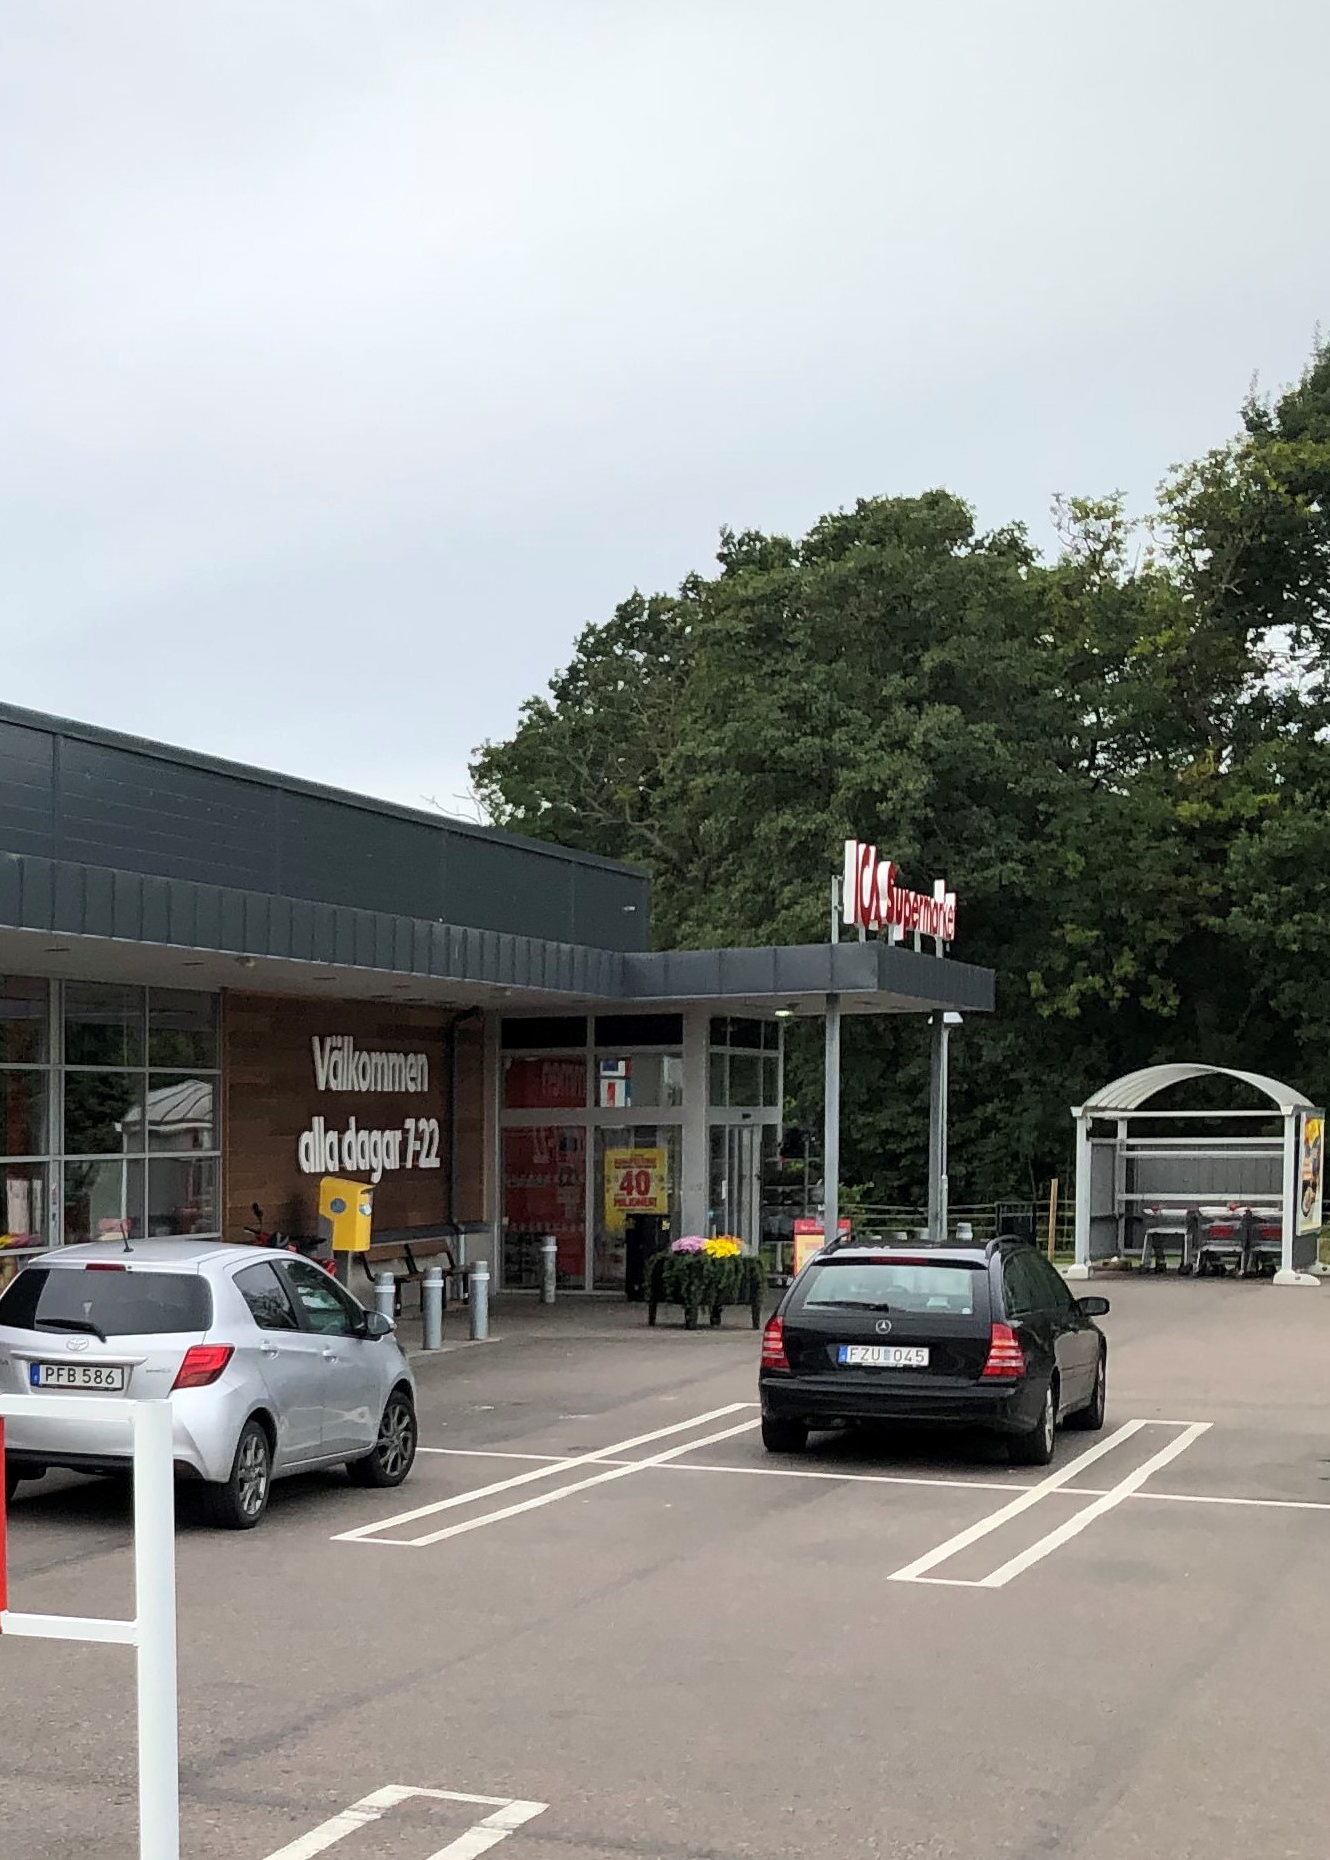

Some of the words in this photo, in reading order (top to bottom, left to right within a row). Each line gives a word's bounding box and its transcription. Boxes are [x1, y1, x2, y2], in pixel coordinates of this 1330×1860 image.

[311, 1035, 429, 1092] Välkommen
[298, 1115, 339, 1173] alla
[341, 1115, 402, 1184] dagar
[404, 1117, 440, 1169] 7-22
[620, 1170, 651, 1196] 40
[849, 1347, 881, 1361] FZU
[893, 1349, 925, 1363] 045
[45, 1366, 77, 1383] PFB
[82, 1368, 115, 1385] 586
